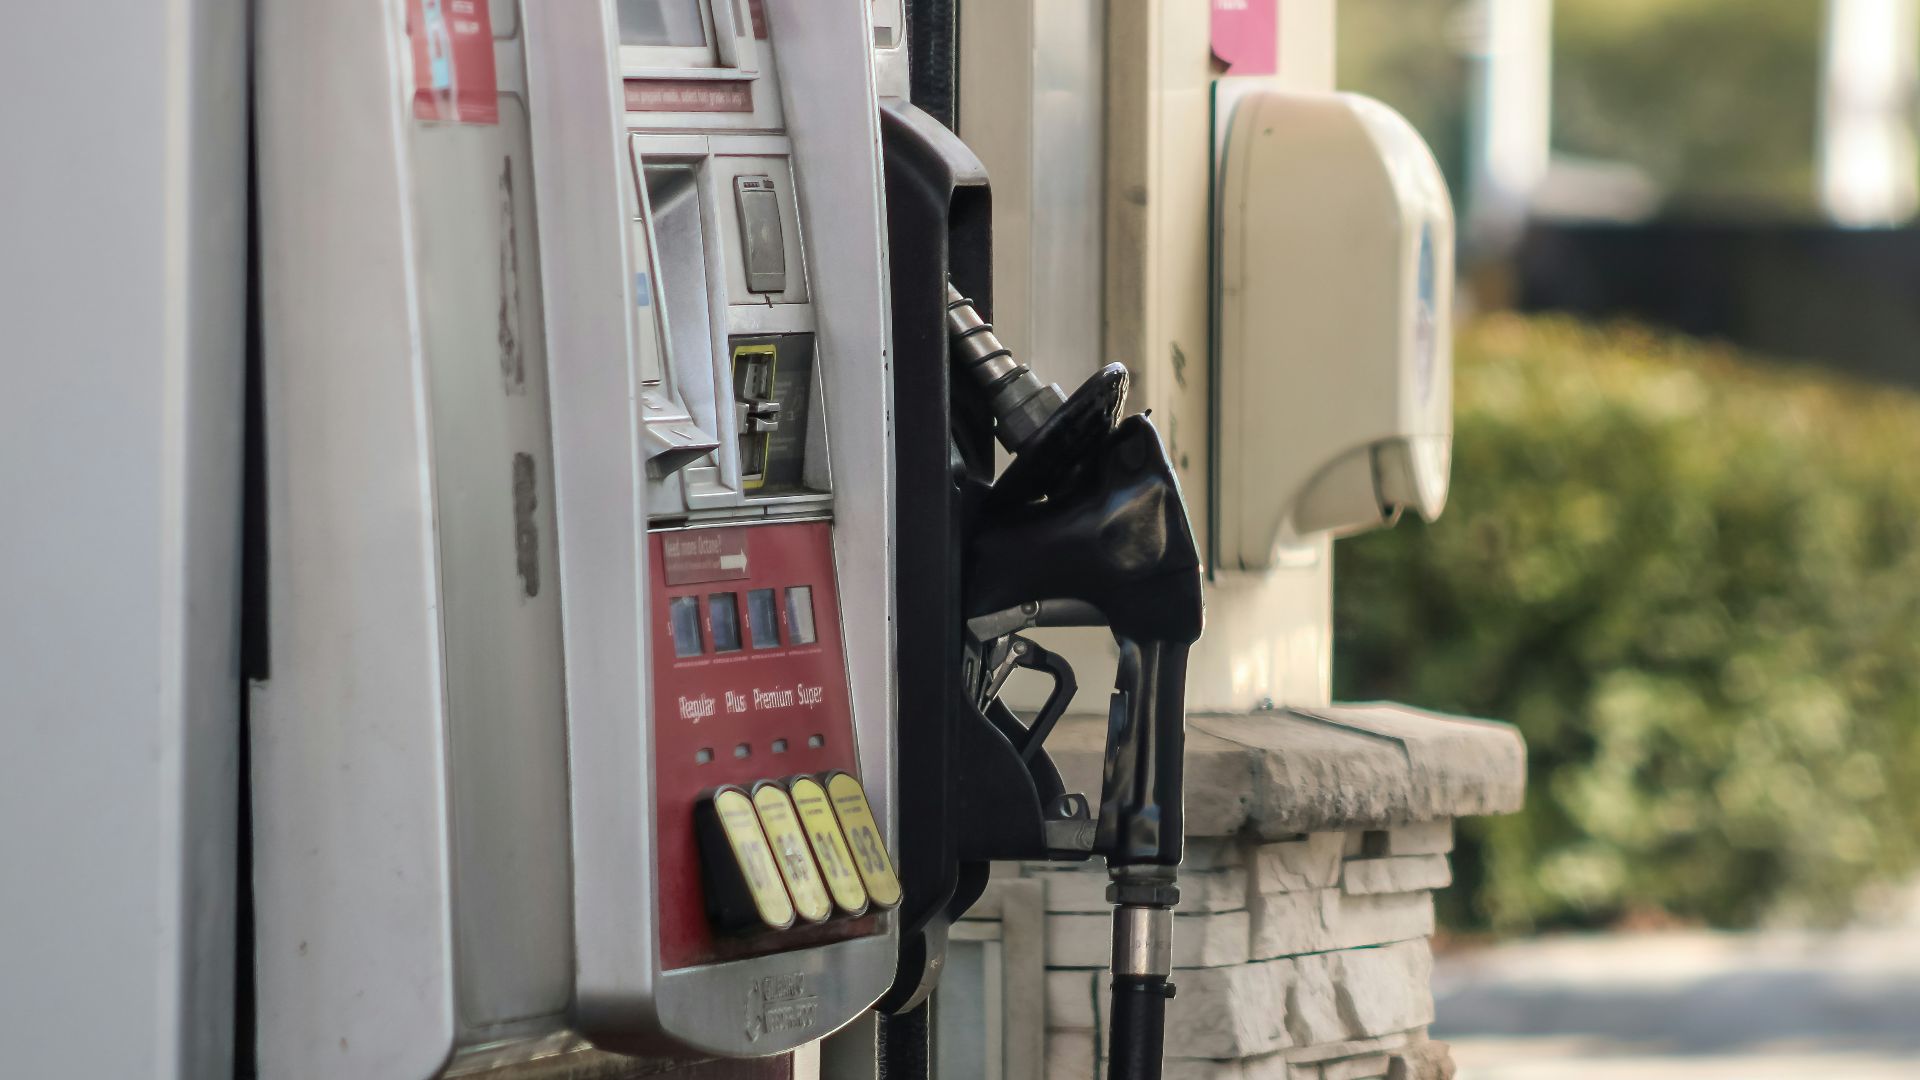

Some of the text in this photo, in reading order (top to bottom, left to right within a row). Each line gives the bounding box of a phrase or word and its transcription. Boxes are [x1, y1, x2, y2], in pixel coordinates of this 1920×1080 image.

[679, 683, 823, 723] Regular Plus Premium Super
[816, 832, 849, 879] 91
[851, 826, 884, 872] 93
